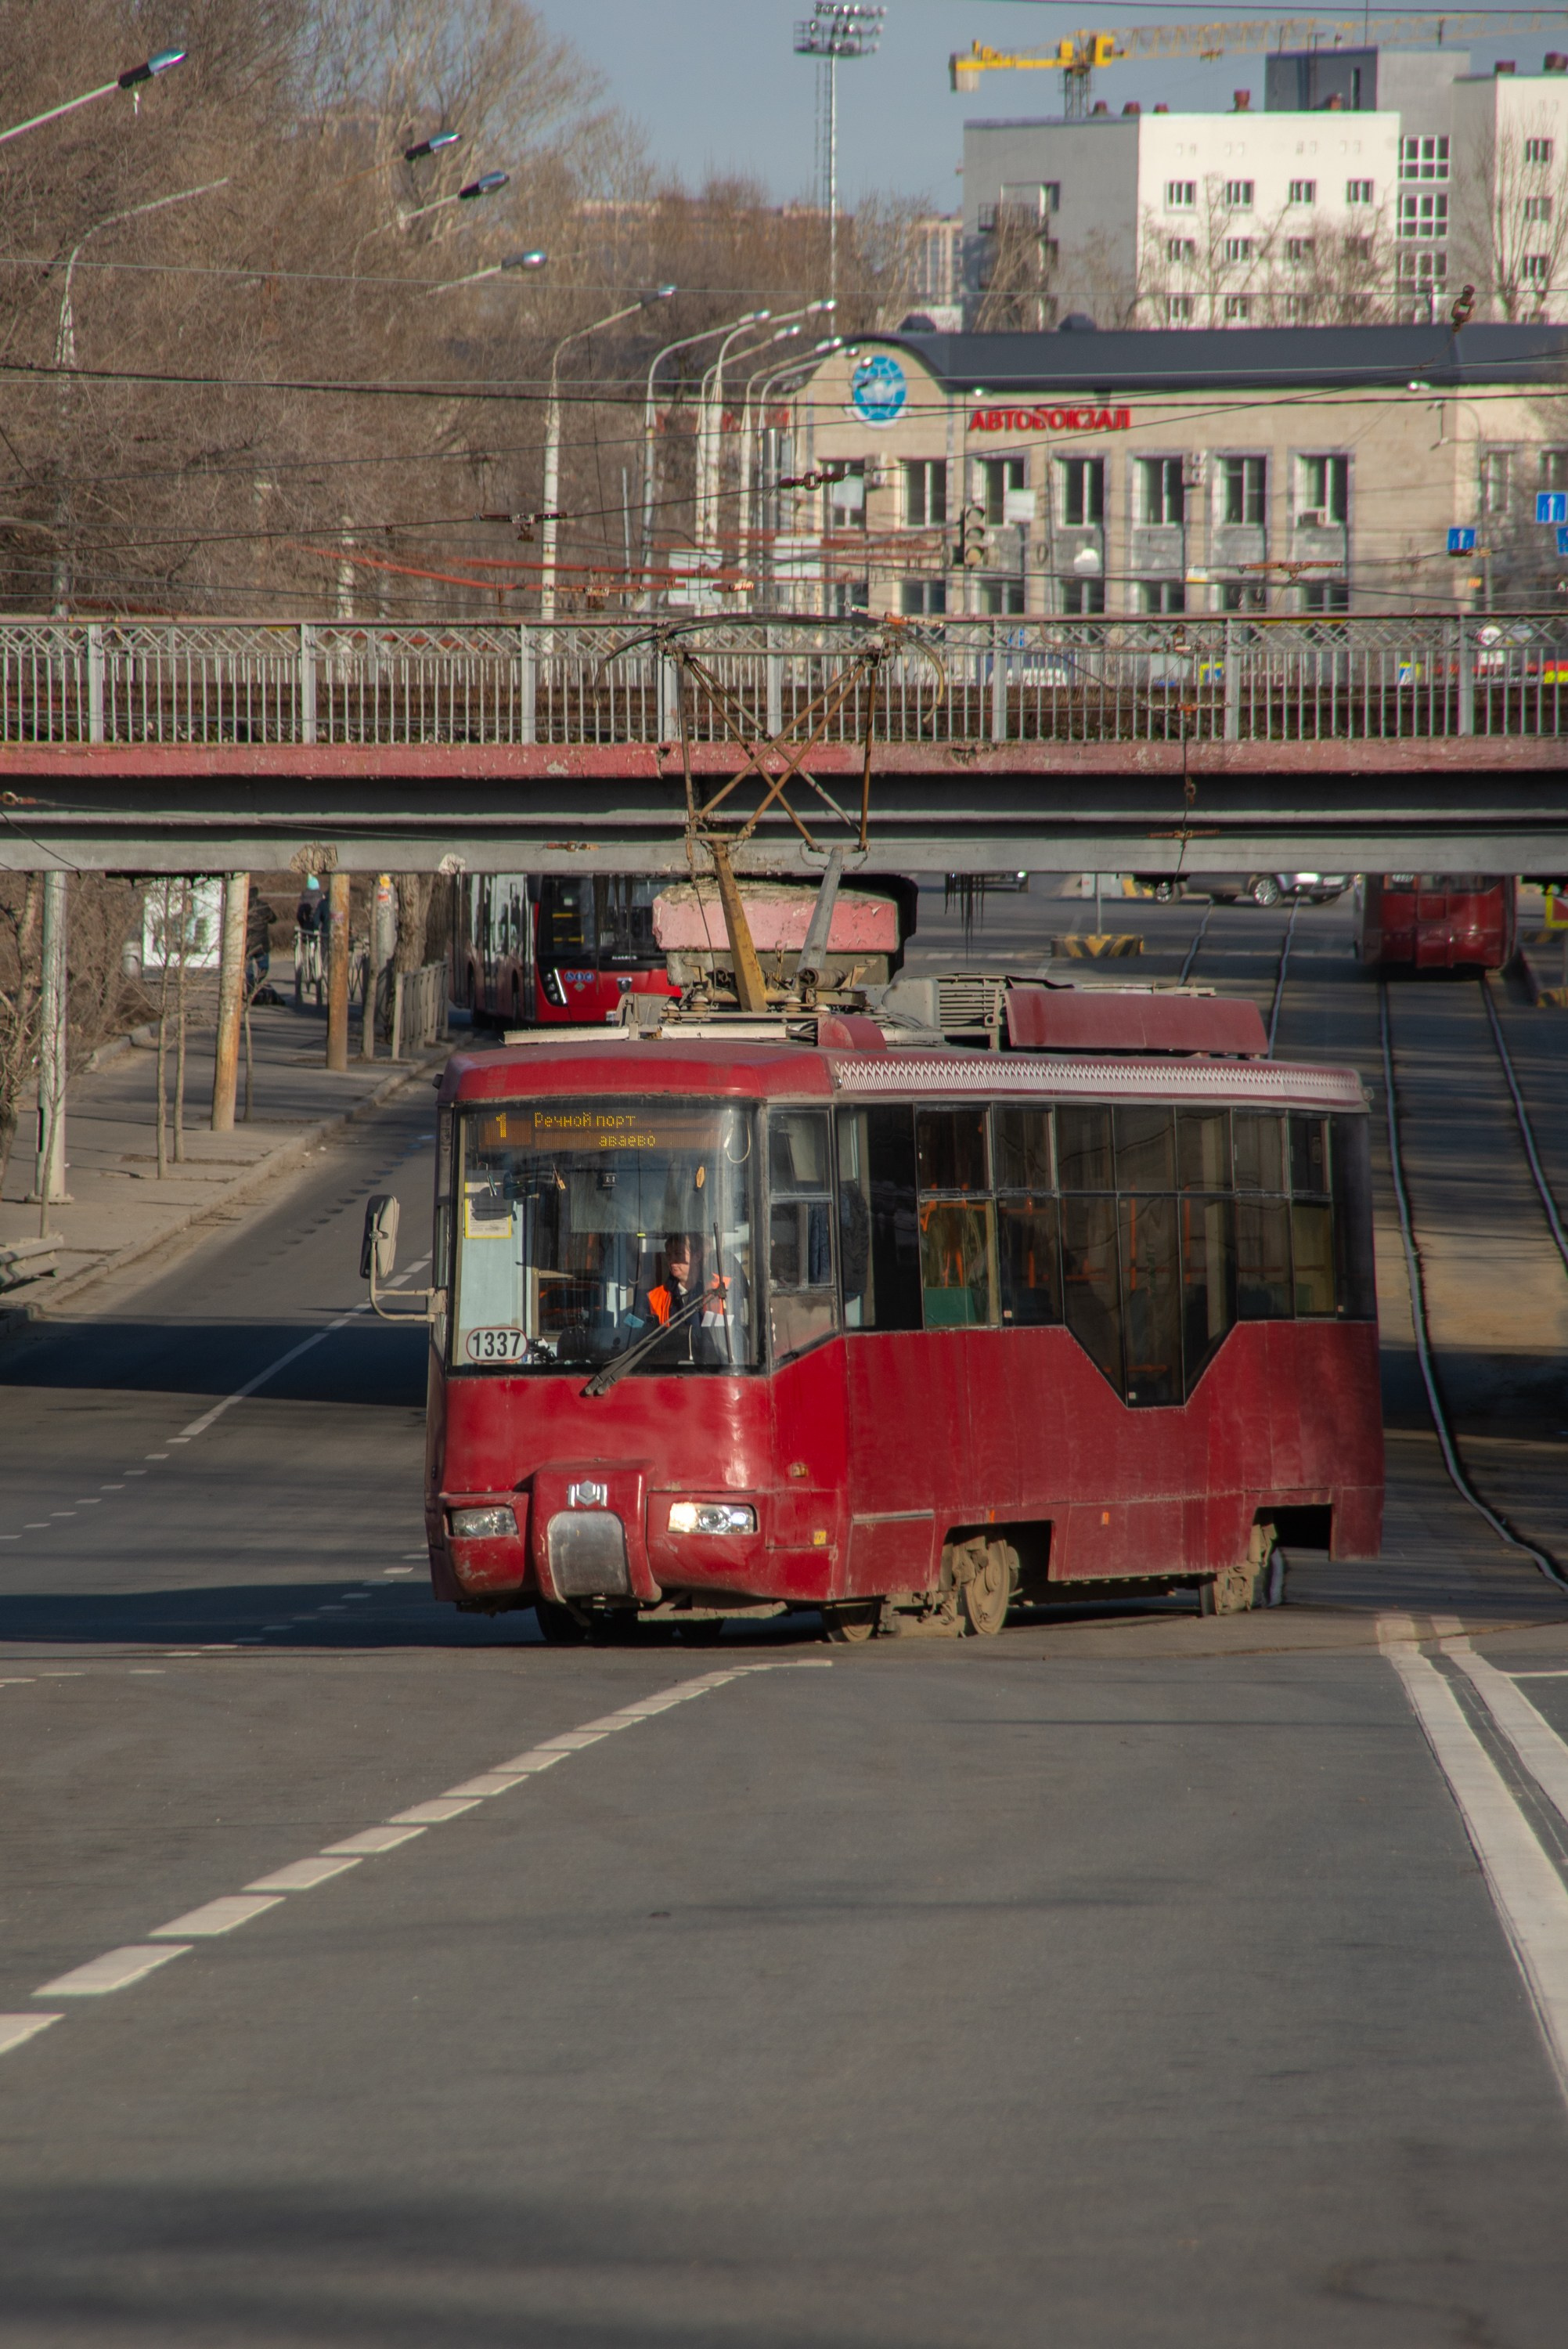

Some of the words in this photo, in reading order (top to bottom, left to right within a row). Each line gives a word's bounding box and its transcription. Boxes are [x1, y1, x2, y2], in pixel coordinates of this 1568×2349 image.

[969, 408, 1131, 431] АВТОВОКЗАЛ
[496, 1113, 506, 1138] 1
[535, 1112, 592, 1128] Речной
[597, 1115, 636, 1128] порт
[599, 1135, 656, 1147] аваево
[473, 1332, 521, 1357] 1337
